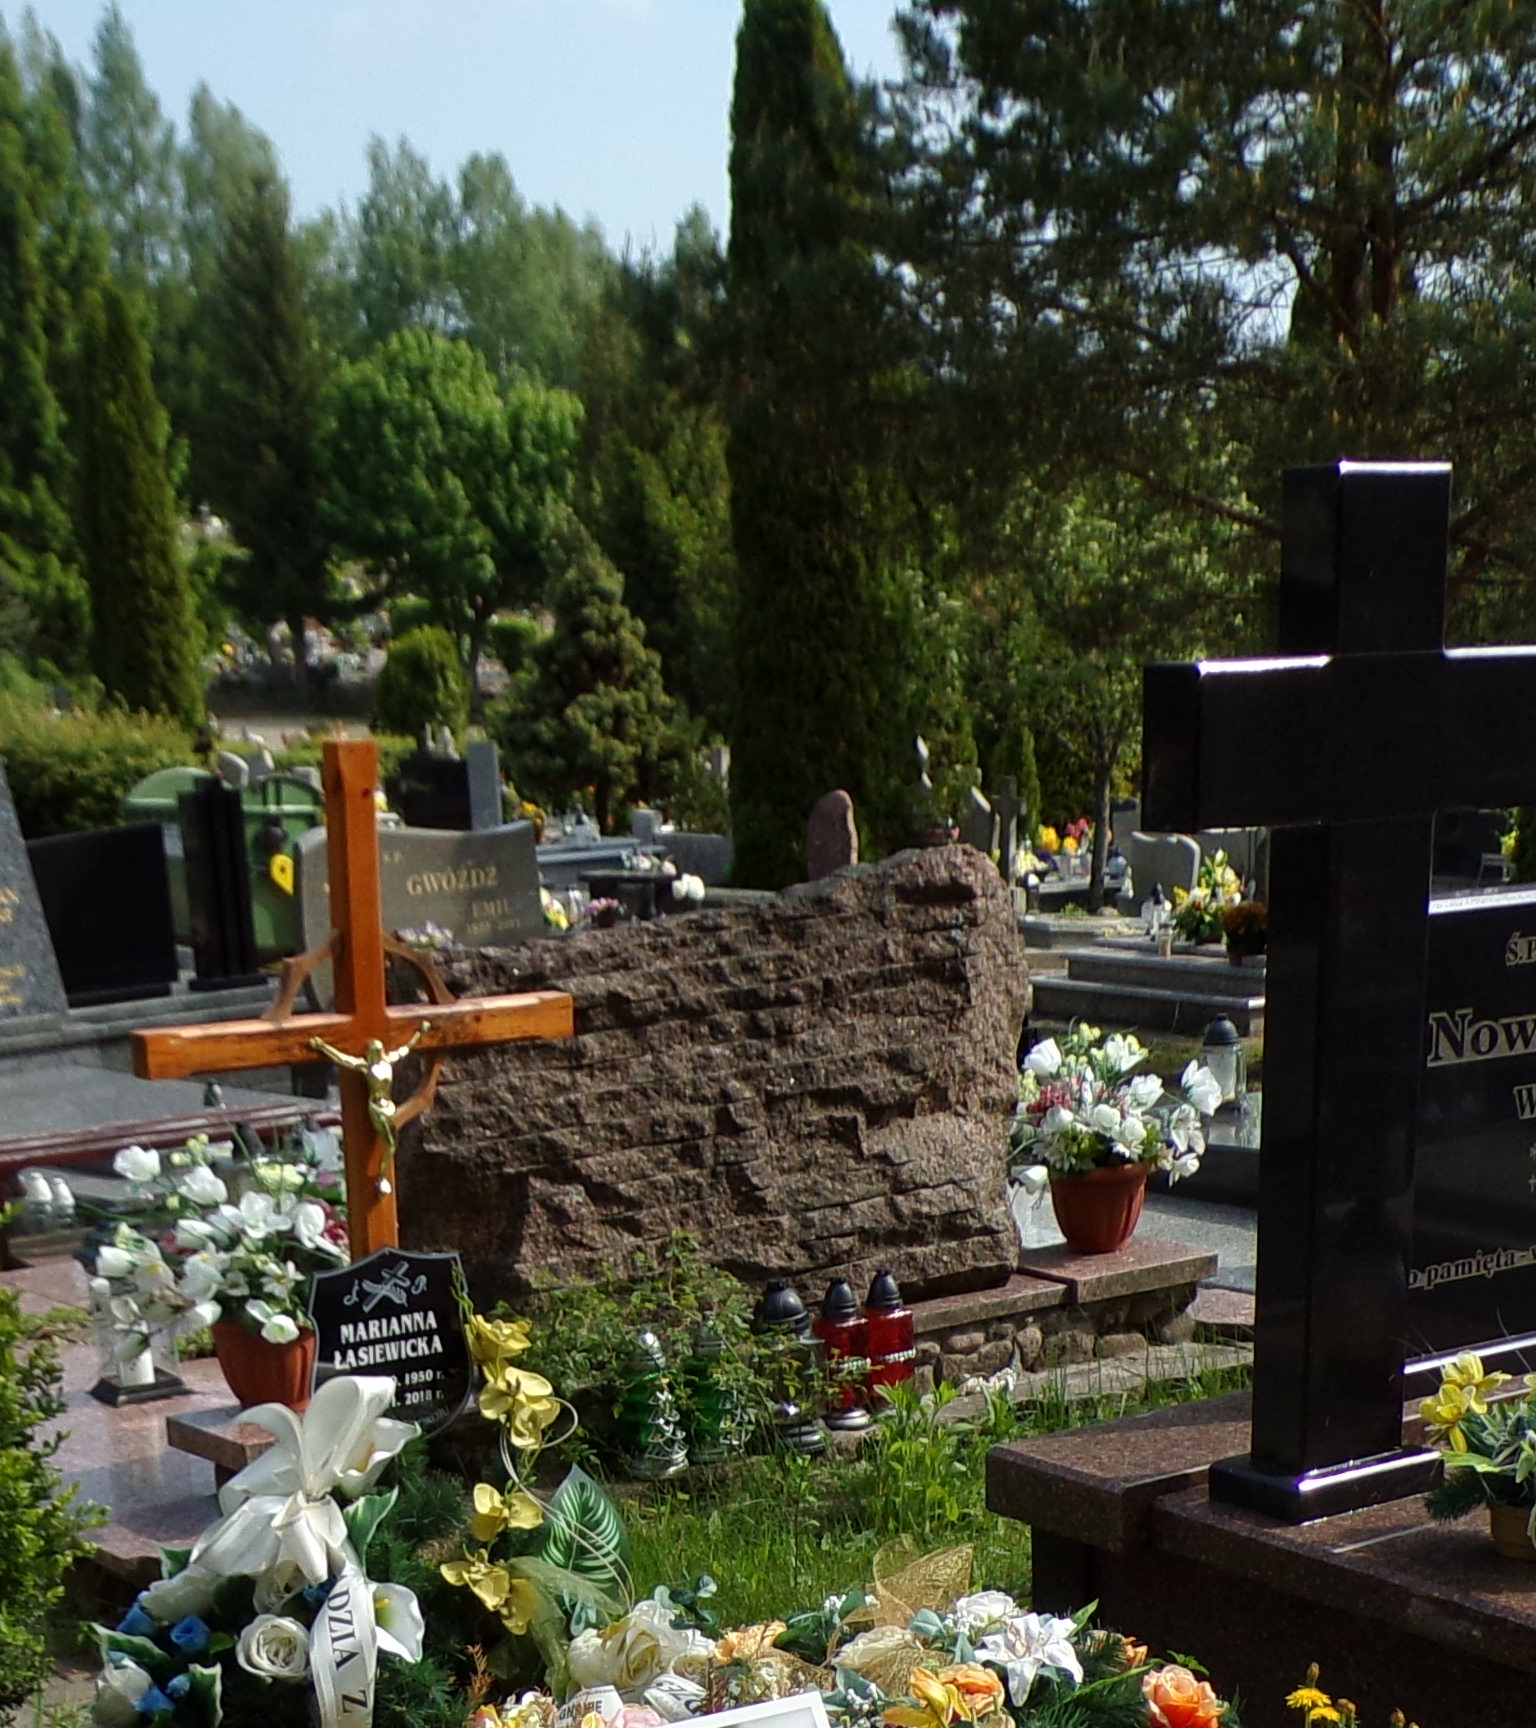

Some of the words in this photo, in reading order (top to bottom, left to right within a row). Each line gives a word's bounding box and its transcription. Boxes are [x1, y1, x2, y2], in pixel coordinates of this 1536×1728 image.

[339, 1310, 439, 1345] MARIANNA
[333, 1335, 444, 1370] ŁASIEWICKA
[404, 1368, 434, 1386] 1950
[404, 1389, 433, 1406] 2018
[326, 1588, 361, 1671] DZIA
[341, 1688, 369, 1714] Z
